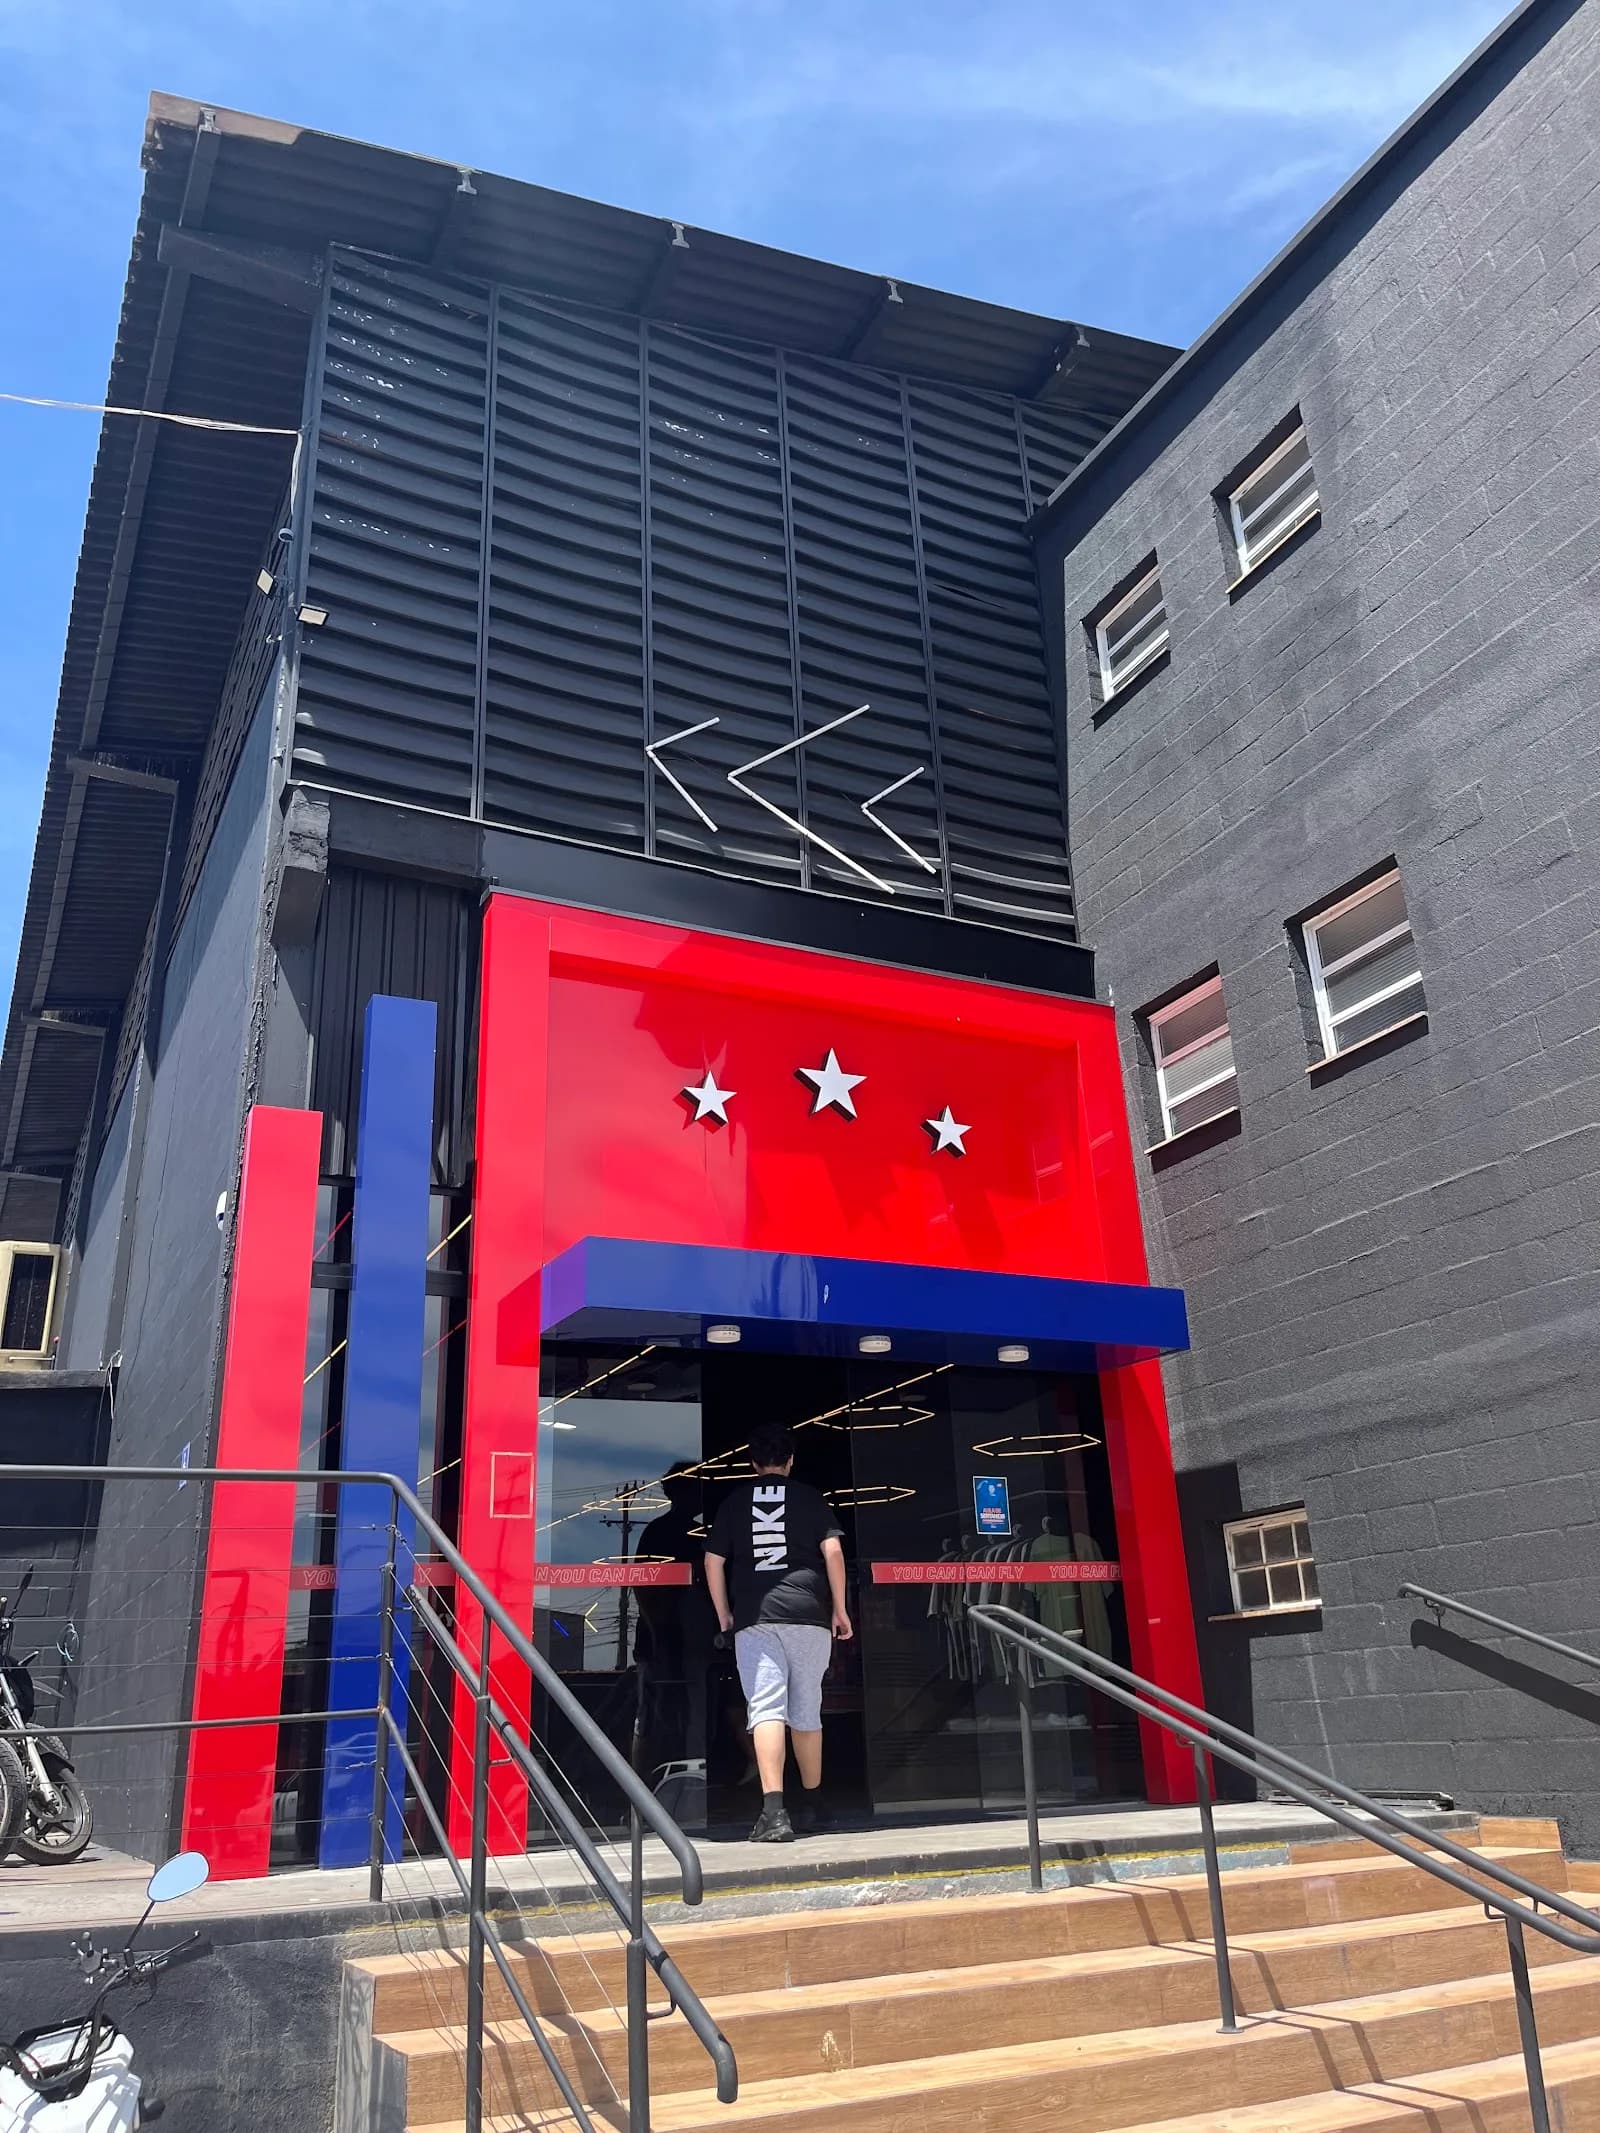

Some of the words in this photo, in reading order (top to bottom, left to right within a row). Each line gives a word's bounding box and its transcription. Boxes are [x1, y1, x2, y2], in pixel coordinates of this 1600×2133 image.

[752, 1486, 788, 1571] NIKE
[550, 1568, 585, 1583] YOU
[589, 1568, 625, 1583] CAN
[629, 1567, 661, 1582] FLY
[893, 1566, 923, 1580] YOU
[926, 1566, 957, 1580] CAN
[966, 1566, 996, 1580] CAN
[998, 1566, 1024, 1579] FLY
[1049, 1565, 1077, 1578] YOU
[1081, 1565, 1107, 1578] CAN
